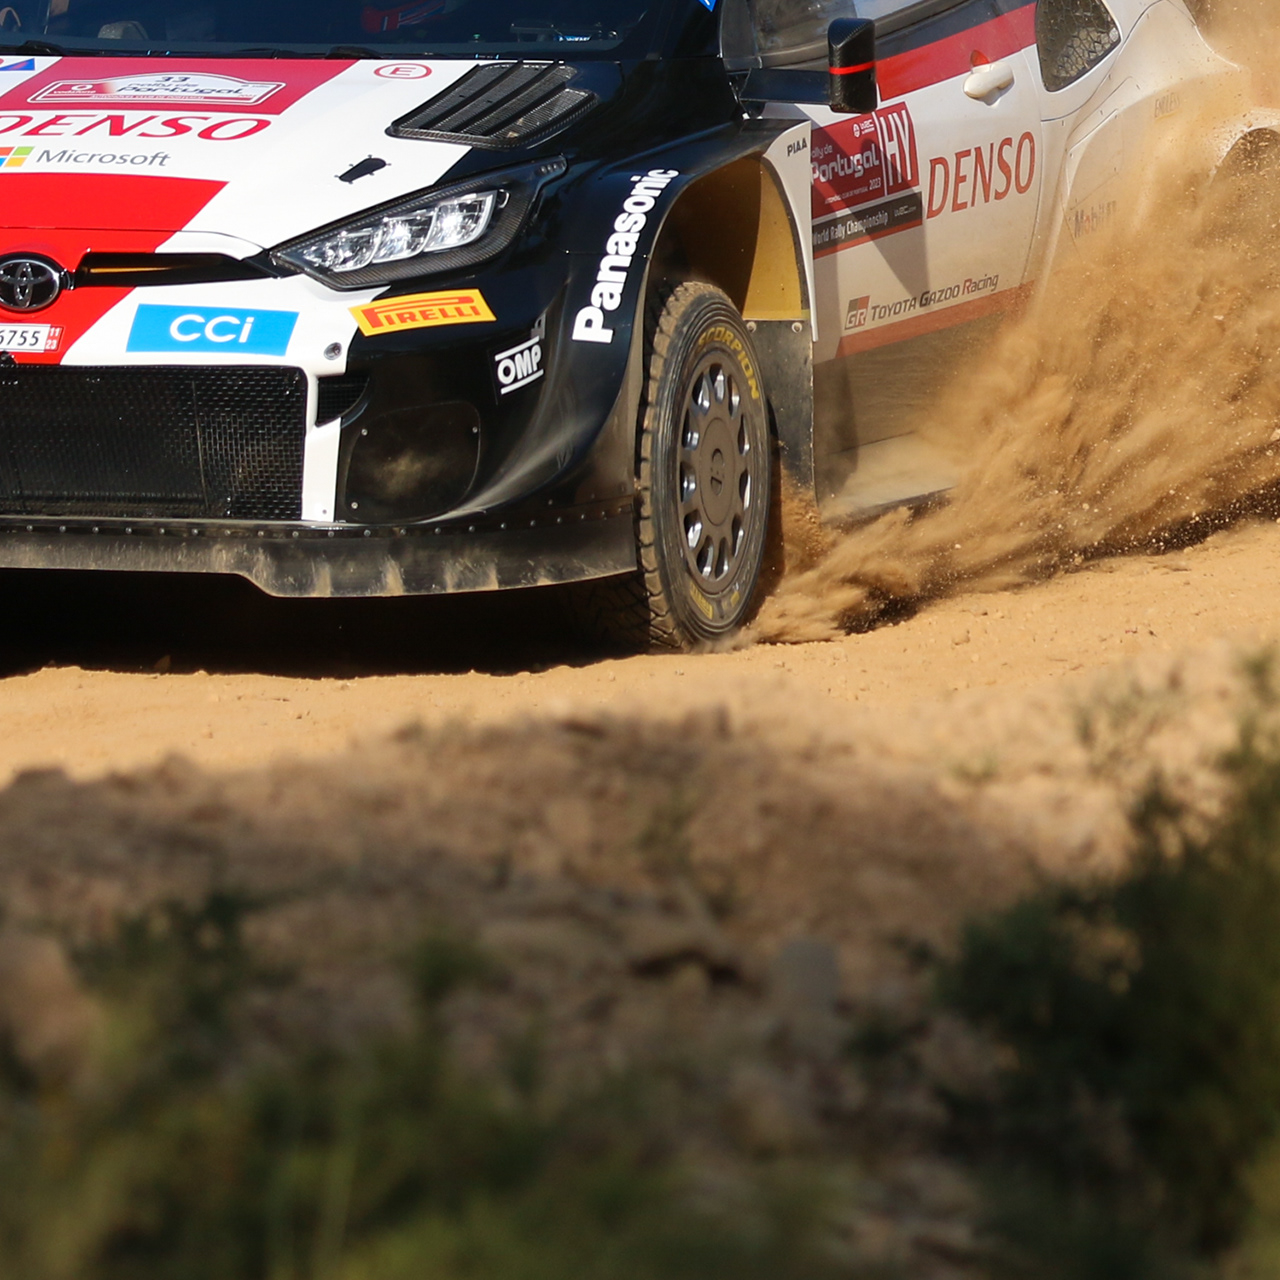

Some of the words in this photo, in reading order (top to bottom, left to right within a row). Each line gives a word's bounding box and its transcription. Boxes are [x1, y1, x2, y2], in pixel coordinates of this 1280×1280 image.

[117, 86, 244, 94] Portugal
[36, 149, 171, 167] Microsoft
[787, 138, 807, 157] PIAA
[824, 144, 833, 155] de
[880, 109, 912, 187] HY
[926, 131, 1035, 220] DENSO
[830, 223, 845, 239] Rally
[847, 210, 888, 234] Championship
[572, 169, 679, 344] Panasonic
[361, 296, 481, 328] PIRELLI
[845, 306, 867, 329] GR
[871, 297, 917, 321] TOYOTA
[919, 284, 960, 307] GAZOO
[961, 274, 999, 295] Racing
[45, 340, 57, 350] 23
[49, 327, 60, 337] 11
[497, 344, 542, 385] OMP
[699, 327, 759, 400] SCORPION
